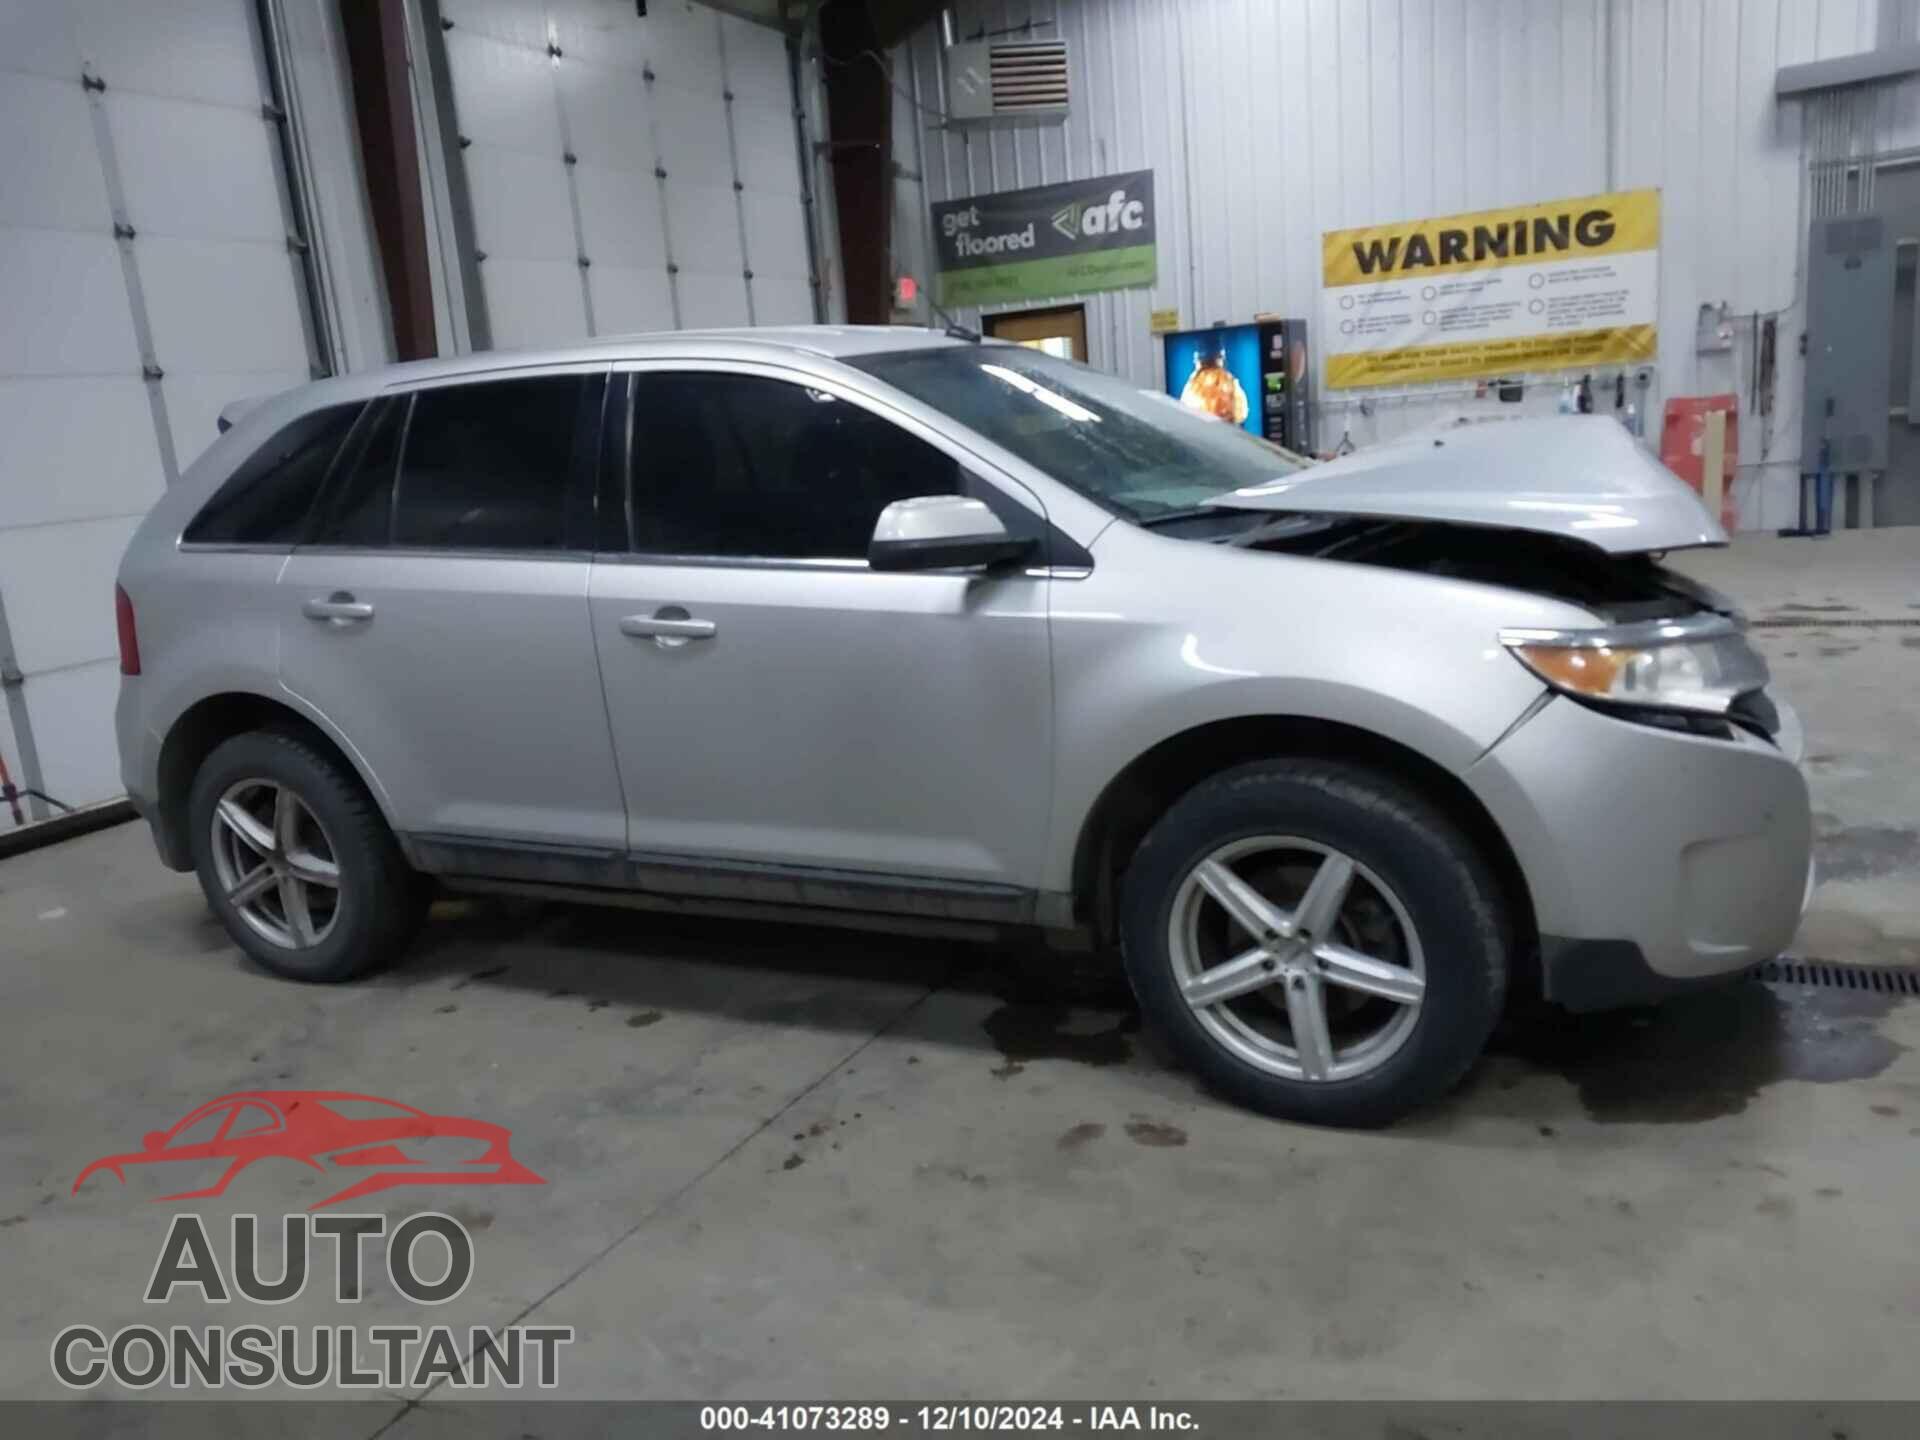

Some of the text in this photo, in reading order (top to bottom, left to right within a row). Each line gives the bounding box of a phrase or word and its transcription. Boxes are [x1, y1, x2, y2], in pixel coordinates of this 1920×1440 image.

[942, 205, 980, 237] get
[1082, 189, 1144, 236] afc
[955, 222, 1036, 257] floored
[1352, 208, 1616, 275] WARNING
